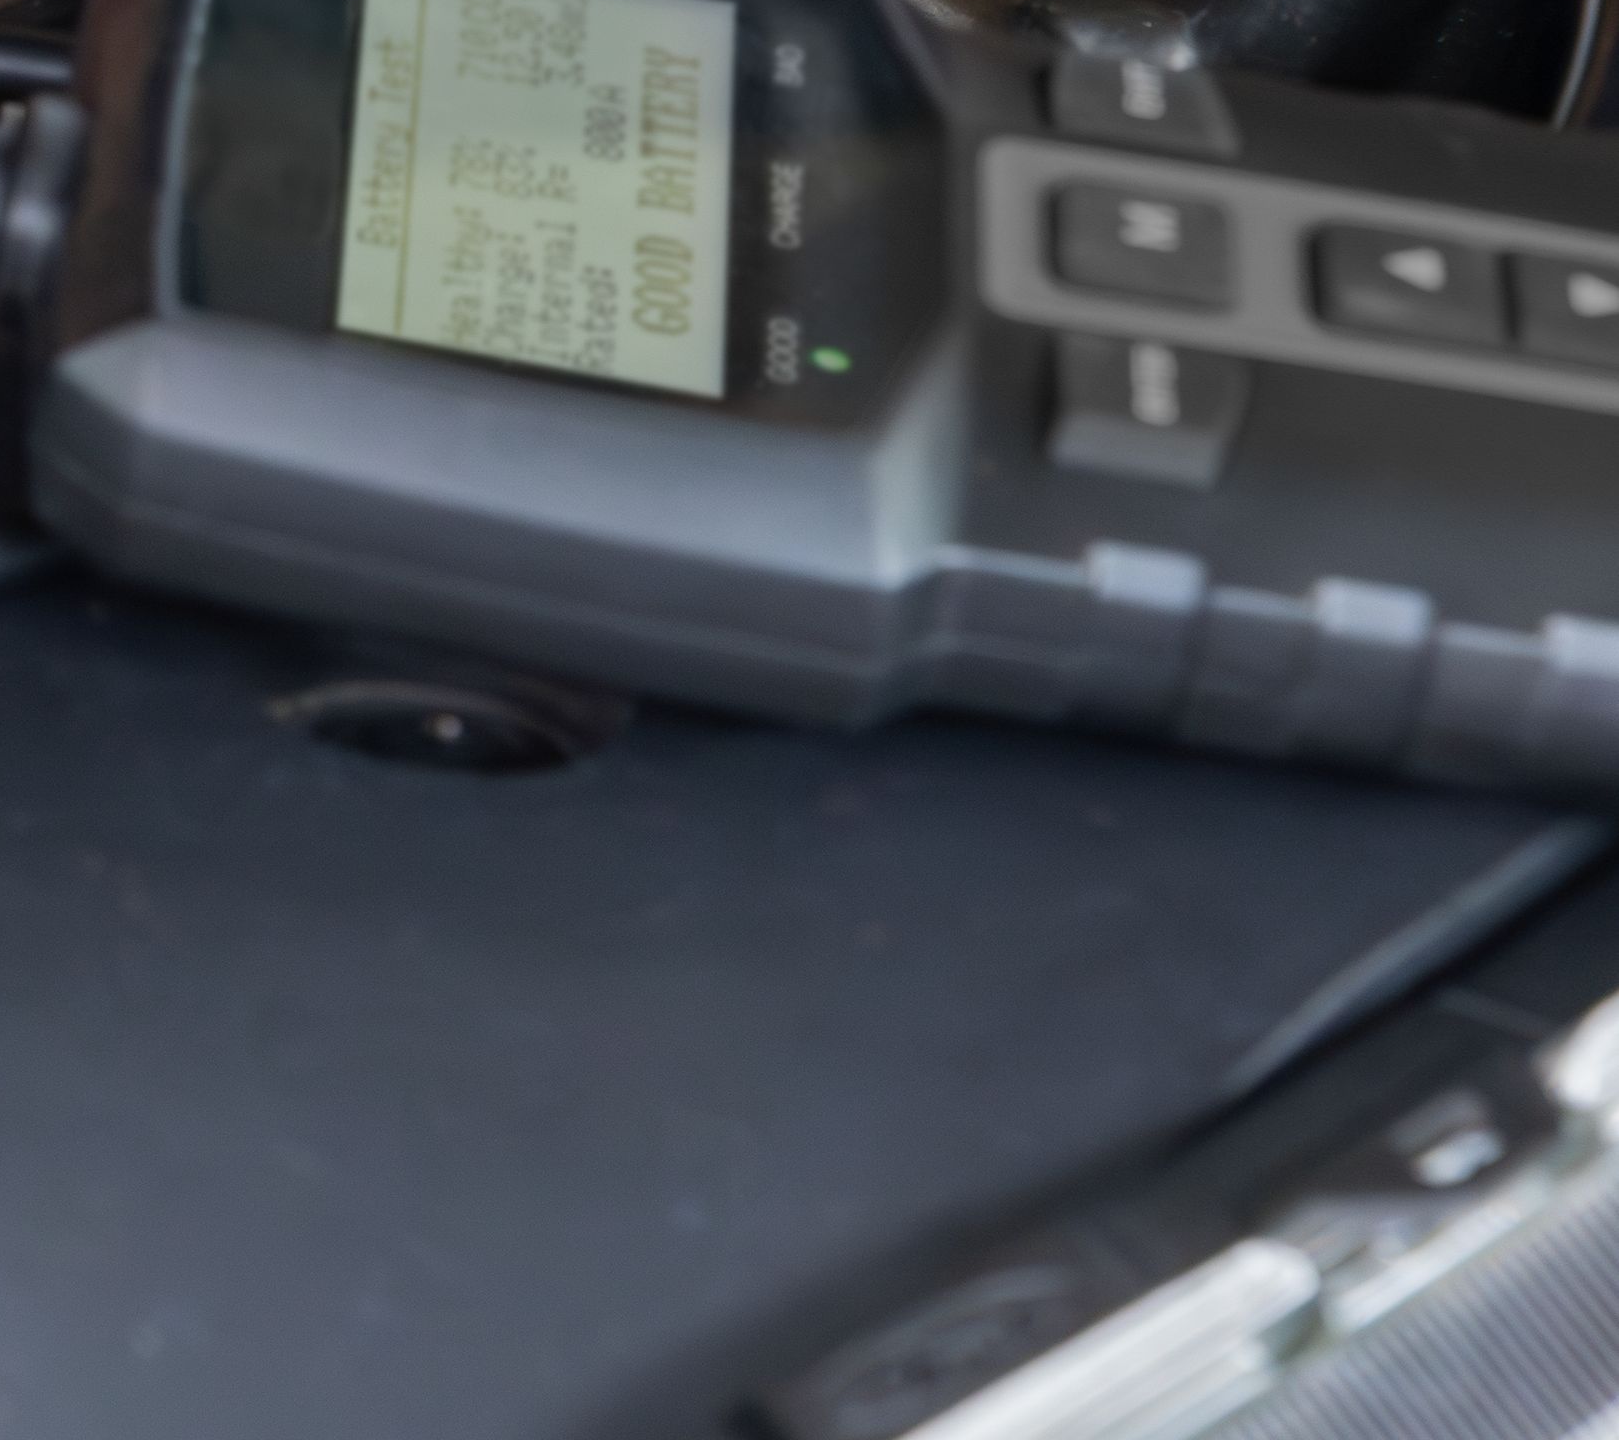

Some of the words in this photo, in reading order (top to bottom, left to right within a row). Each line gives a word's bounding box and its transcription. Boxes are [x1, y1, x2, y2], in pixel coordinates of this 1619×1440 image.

[369, 37, 411, 104] Test
[356, 120, 415, 248] Battery
[637, 48, 700, 215] BATTERY
[769, 161, 804, 249] CHARGE
[486, 234, 535, 351] Charge:
[531, 219, 576, 363] Internal
[574, 264, 617, 369] Rated:
[631, 236, 693, 334] GOOD
[766, 316, 800, 384] GOOD
